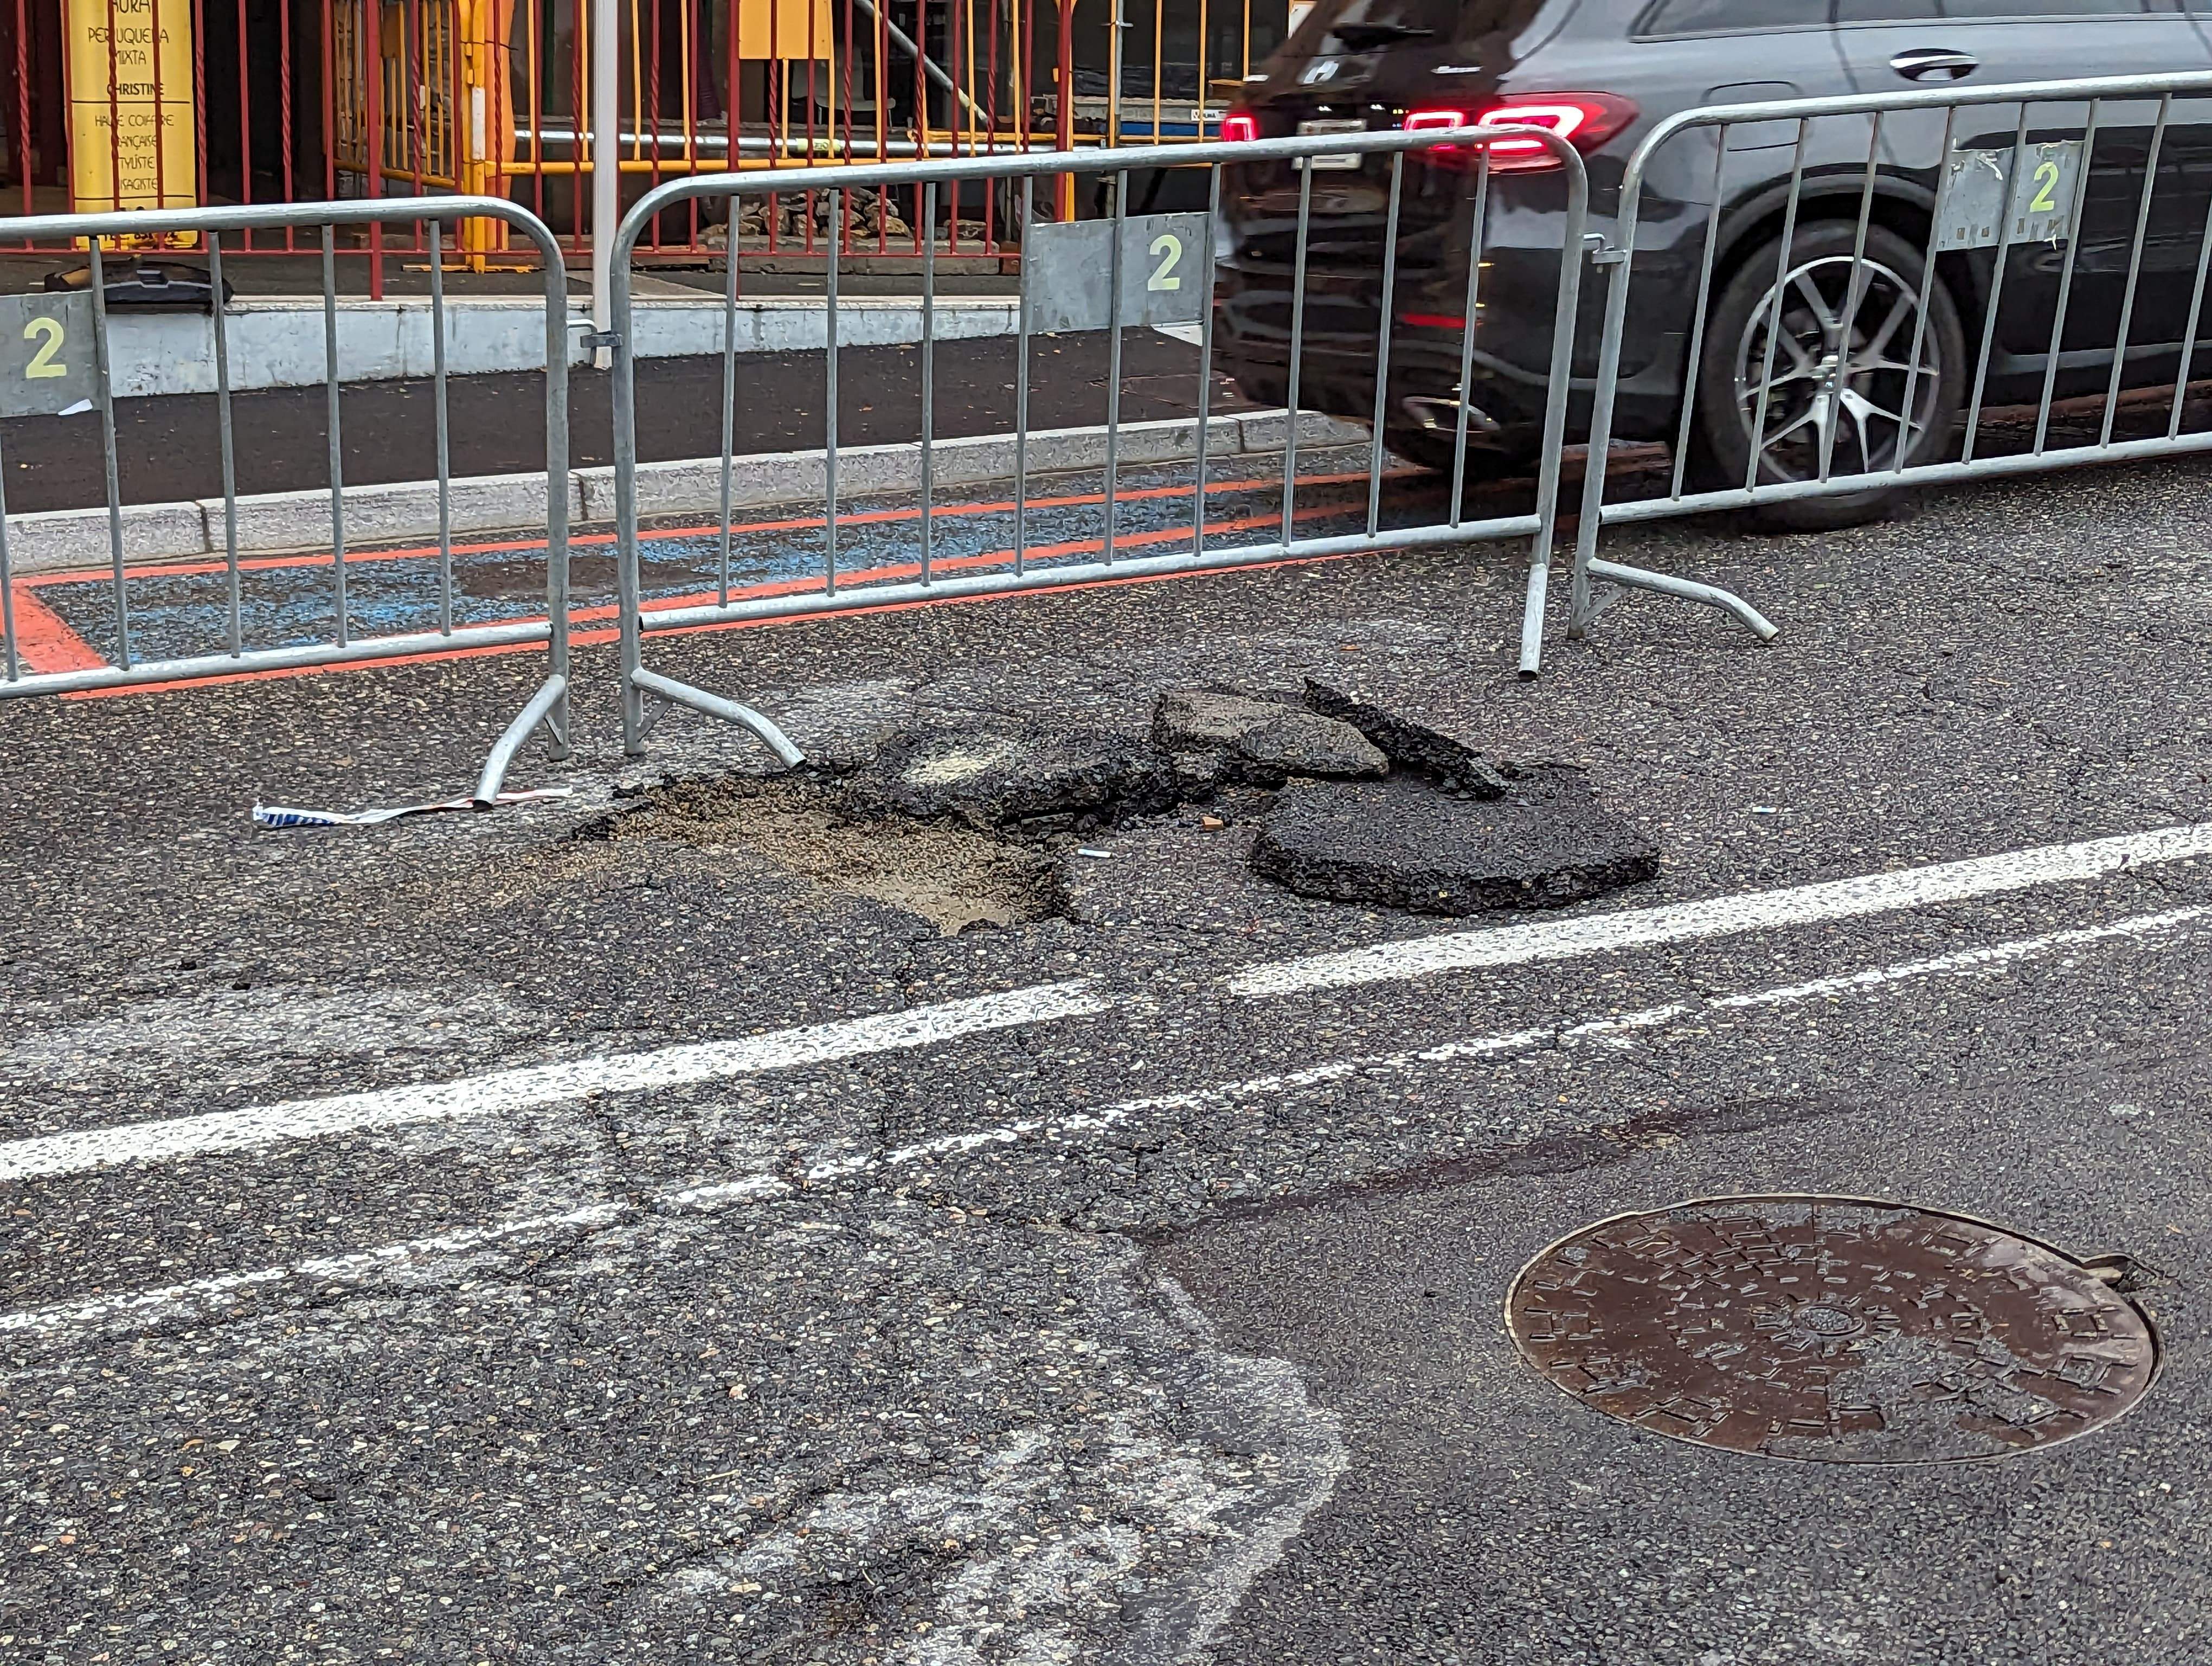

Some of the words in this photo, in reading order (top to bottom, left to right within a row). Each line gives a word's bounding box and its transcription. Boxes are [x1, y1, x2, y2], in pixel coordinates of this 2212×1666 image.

[88, 27, 169, 45] PERUQUEA
[2029, 161, 2059, 213] 2
[1147, 234, 1182, 291] 2
[24, 317, 67, 379] 2
